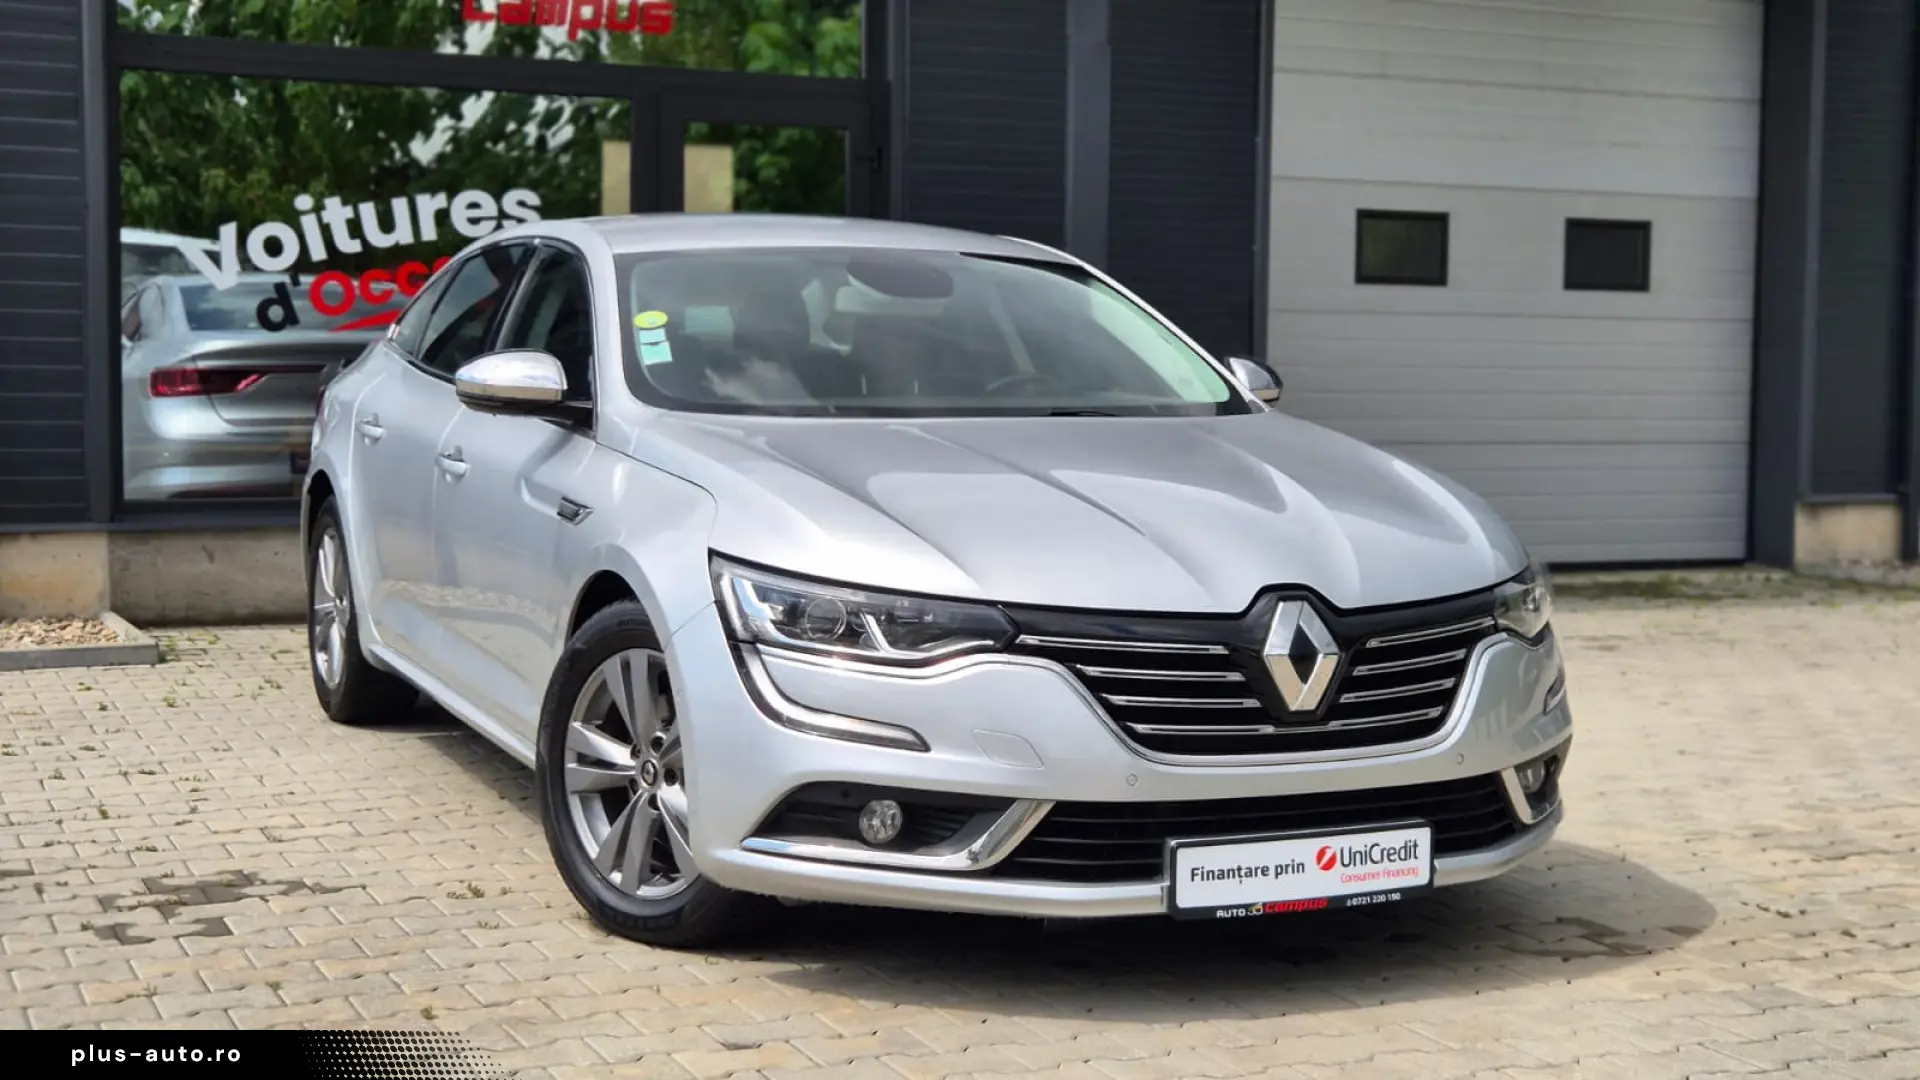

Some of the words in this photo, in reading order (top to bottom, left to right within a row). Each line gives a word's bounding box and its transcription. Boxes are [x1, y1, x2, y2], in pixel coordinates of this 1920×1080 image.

[176, 188, 543, 290] Voitures
[1340, 839, 1419, 868] UniCredit
[1274, 858, 1305, 880] prin
[1340, 872, 1381, 884] Consumer
[1216, 908, 1246, 918] AUTO
